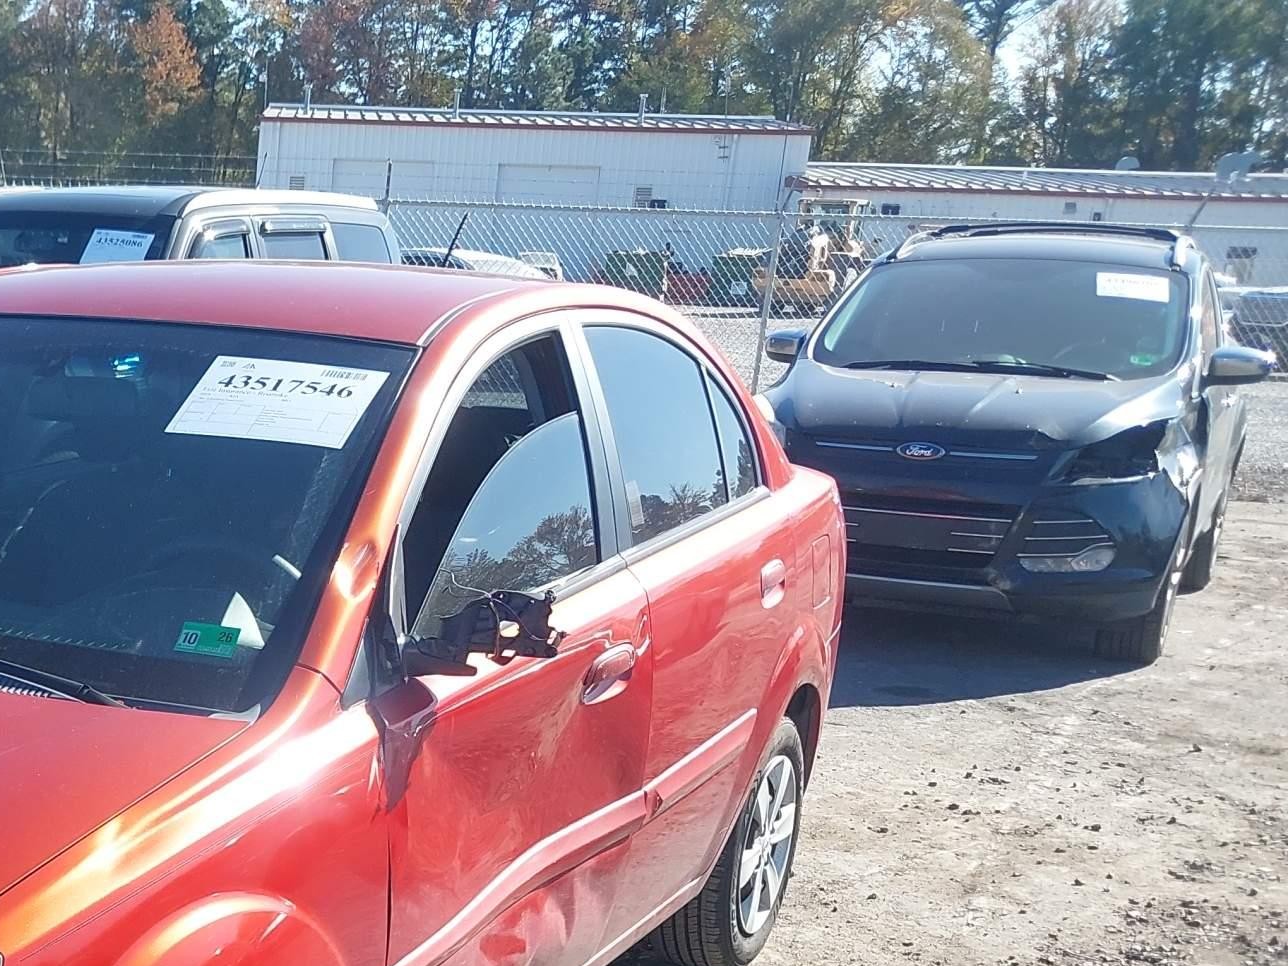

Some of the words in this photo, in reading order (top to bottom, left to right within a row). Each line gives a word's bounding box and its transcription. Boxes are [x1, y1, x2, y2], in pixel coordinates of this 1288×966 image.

[218, 374, 353, 398] 43517546
[906, 444, 933, 456] Ford
[182, 631, 198, 645] 10
